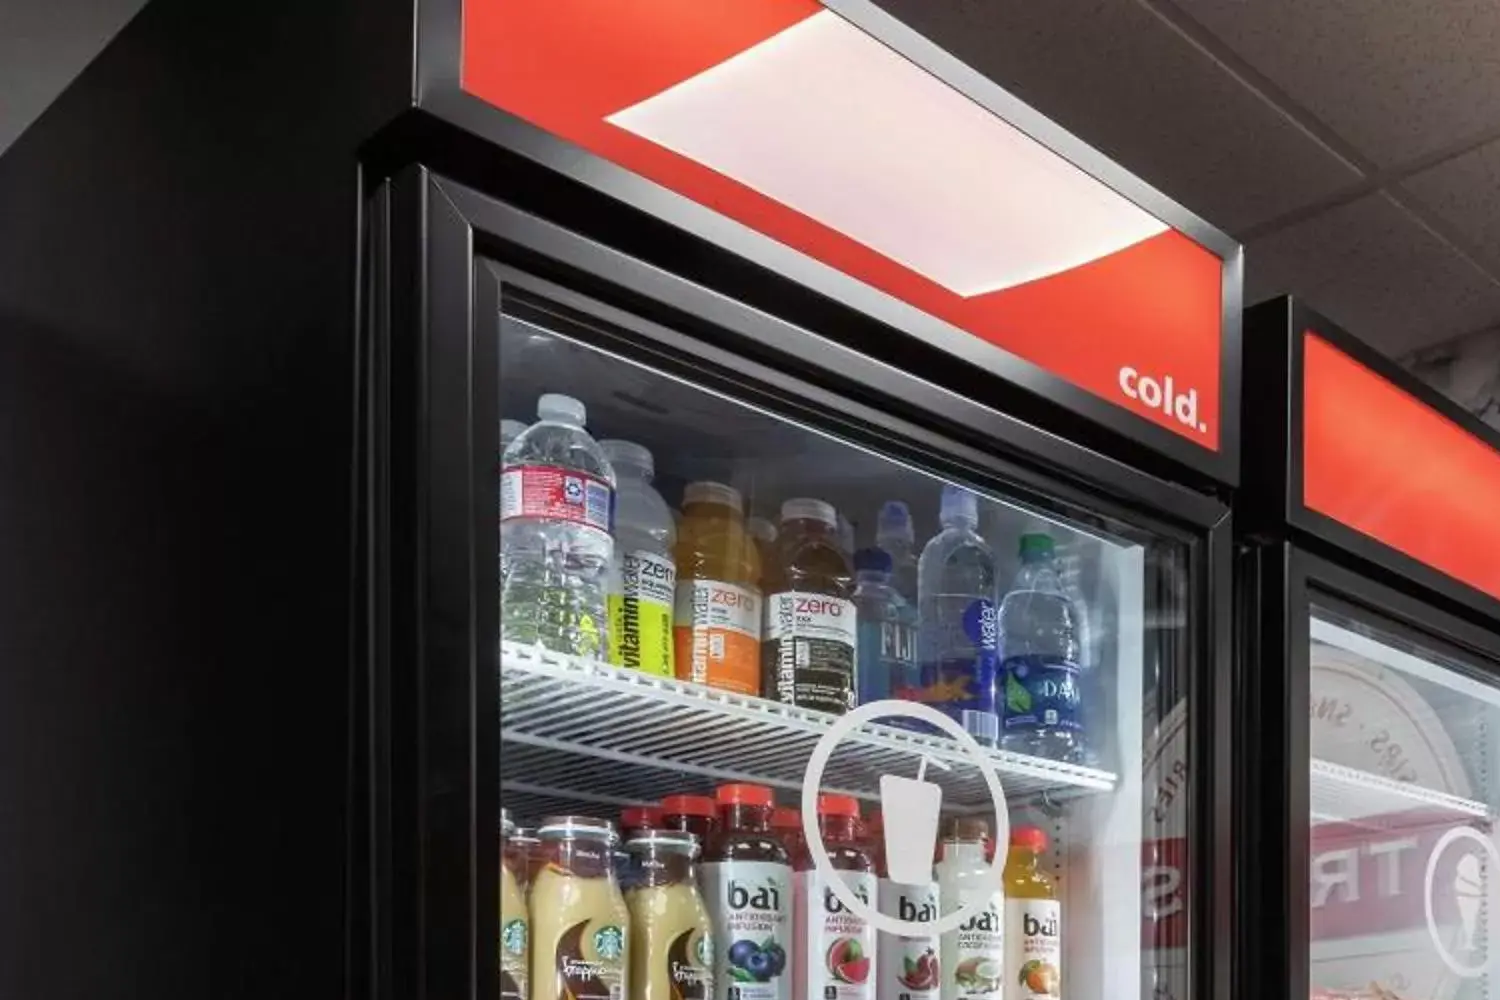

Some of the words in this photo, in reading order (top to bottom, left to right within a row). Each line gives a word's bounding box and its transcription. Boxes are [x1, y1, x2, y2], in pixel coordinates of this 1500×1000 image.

[1119, 366, 1208, 433] cold.
[641, 559, 676, 586] zer
[796, 598, 843, 617] zero
[728, 876, 780, 912] bai
[899, 893, 938, 923] bai
[1022, 911, 1059, 937] bai
